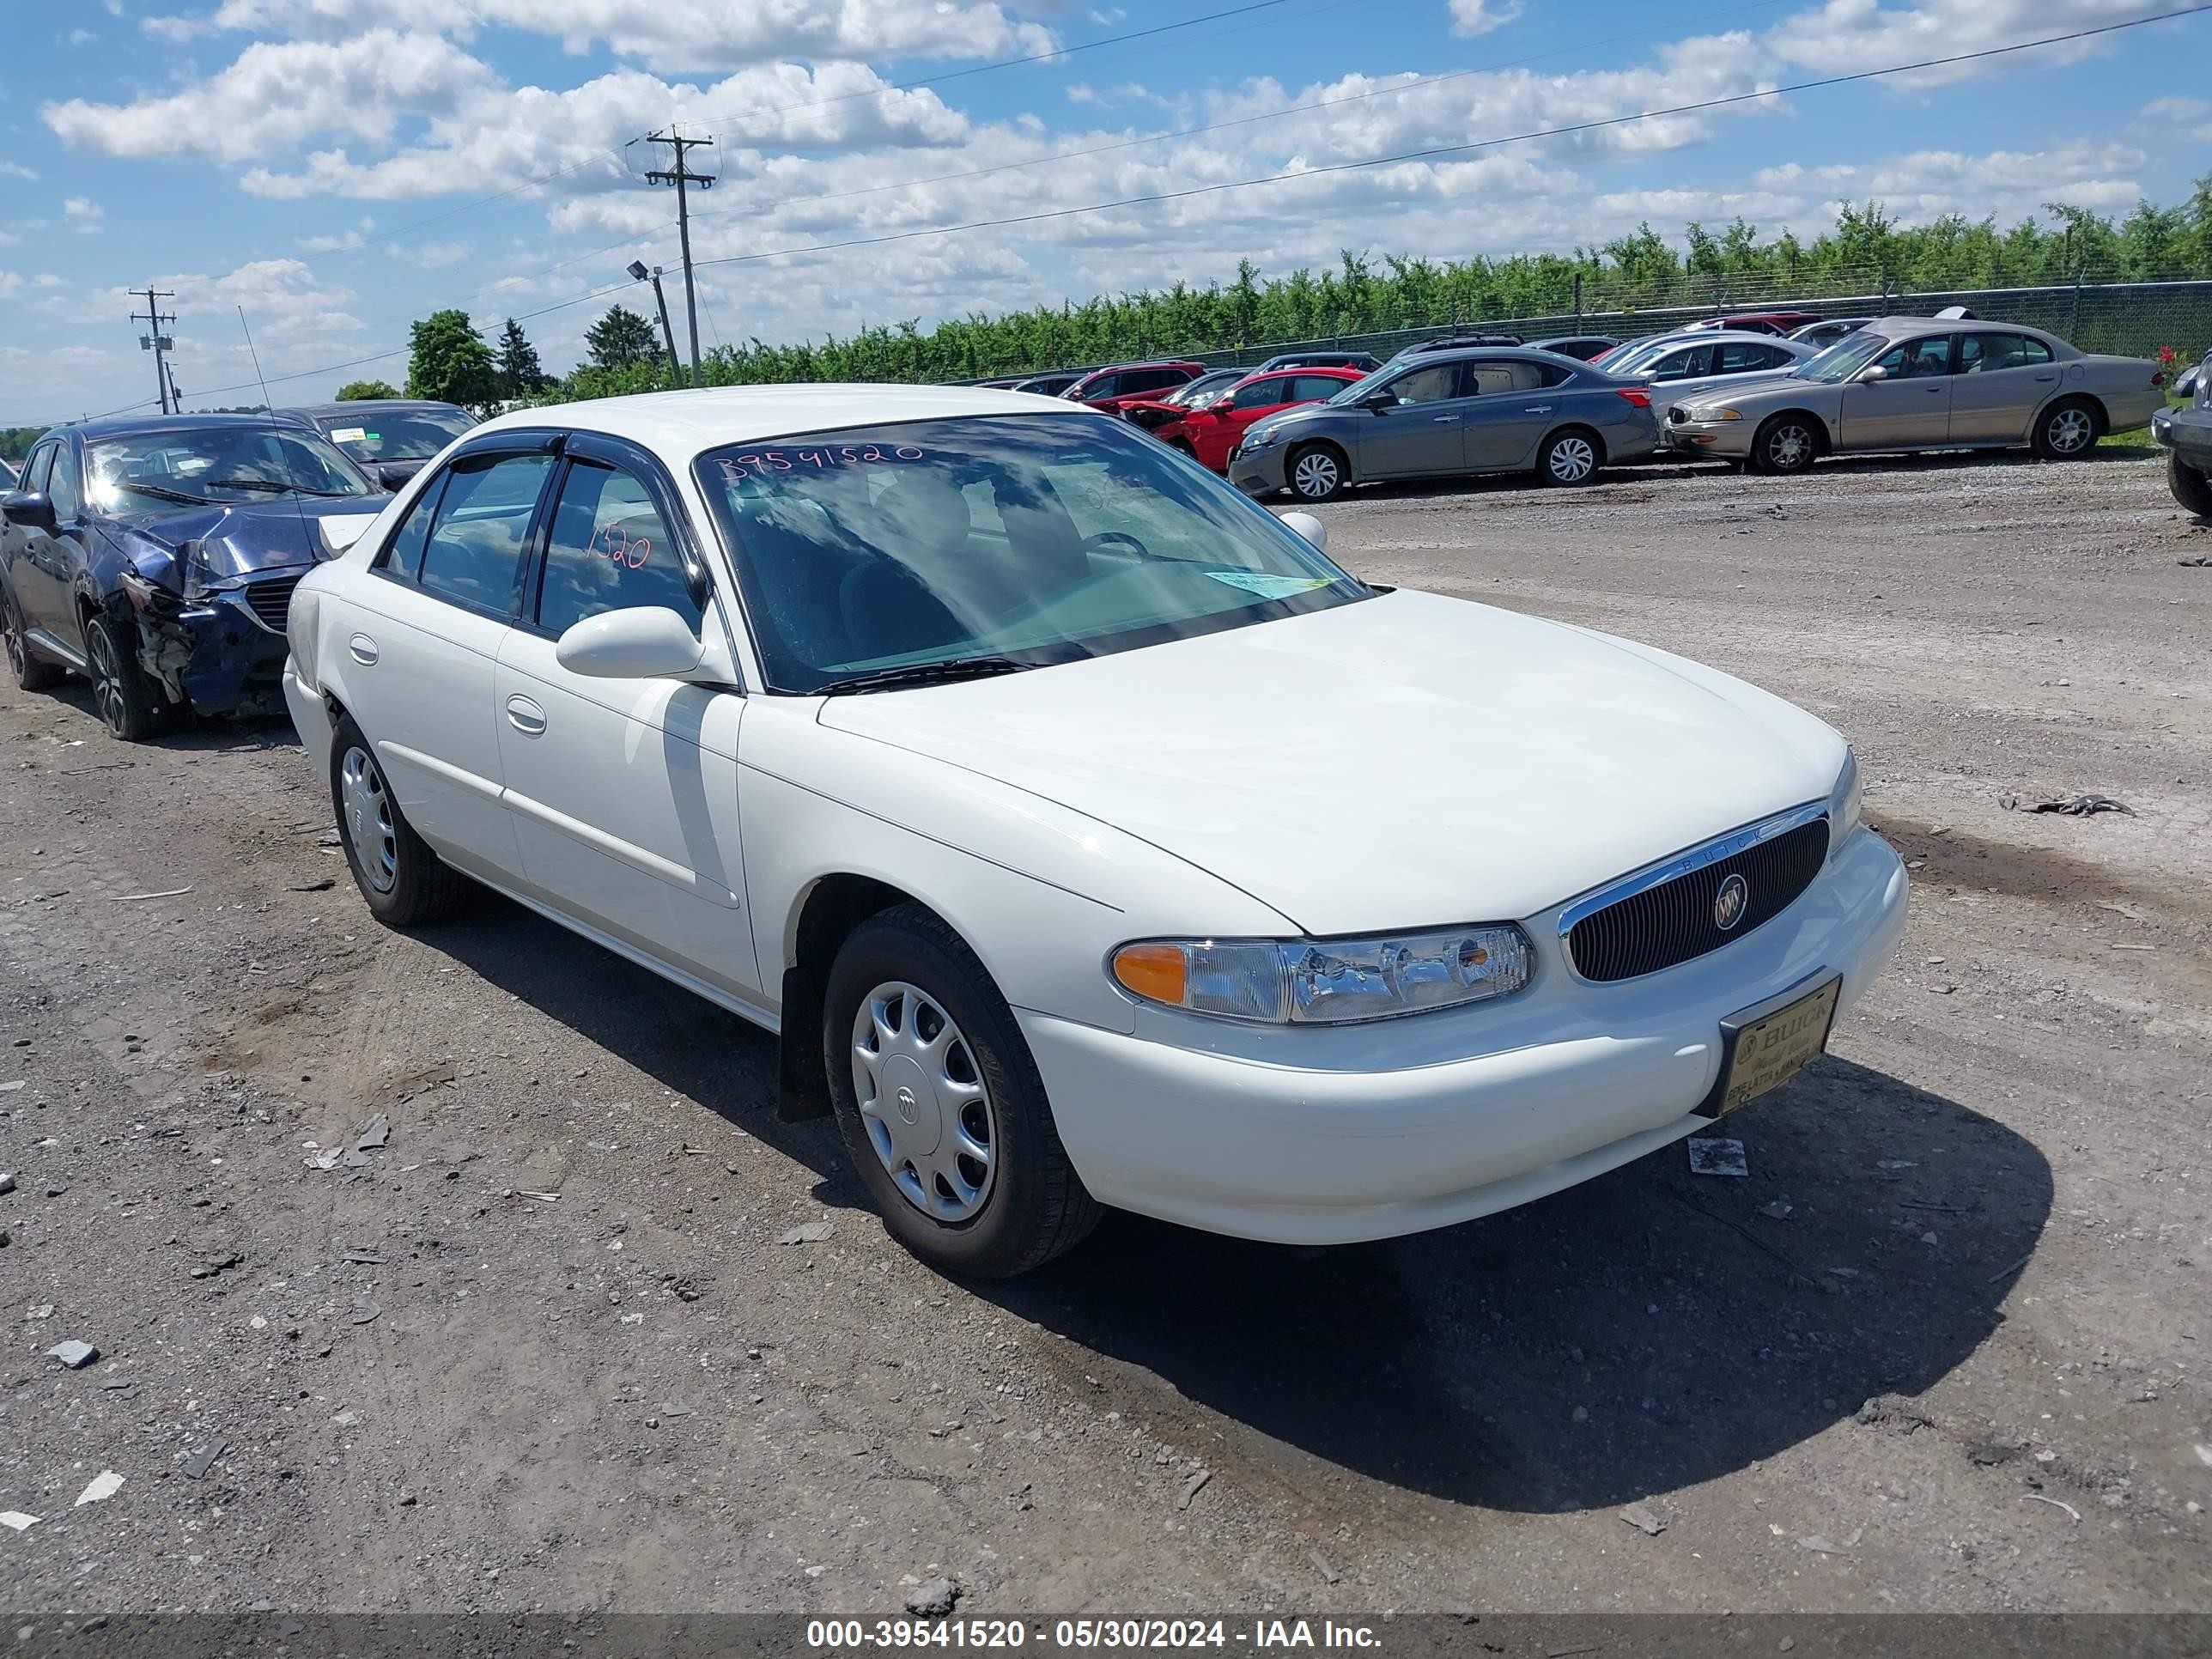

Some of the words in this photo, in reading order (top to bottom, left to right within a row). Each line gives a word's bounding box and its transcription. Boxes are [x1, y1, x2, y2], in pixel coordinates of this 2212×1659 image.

[586, 521, 651, 569] 1520
[1681, 830, 1765, 871] BUICK
[1762, 1004, 1826, 1049] BUICK
